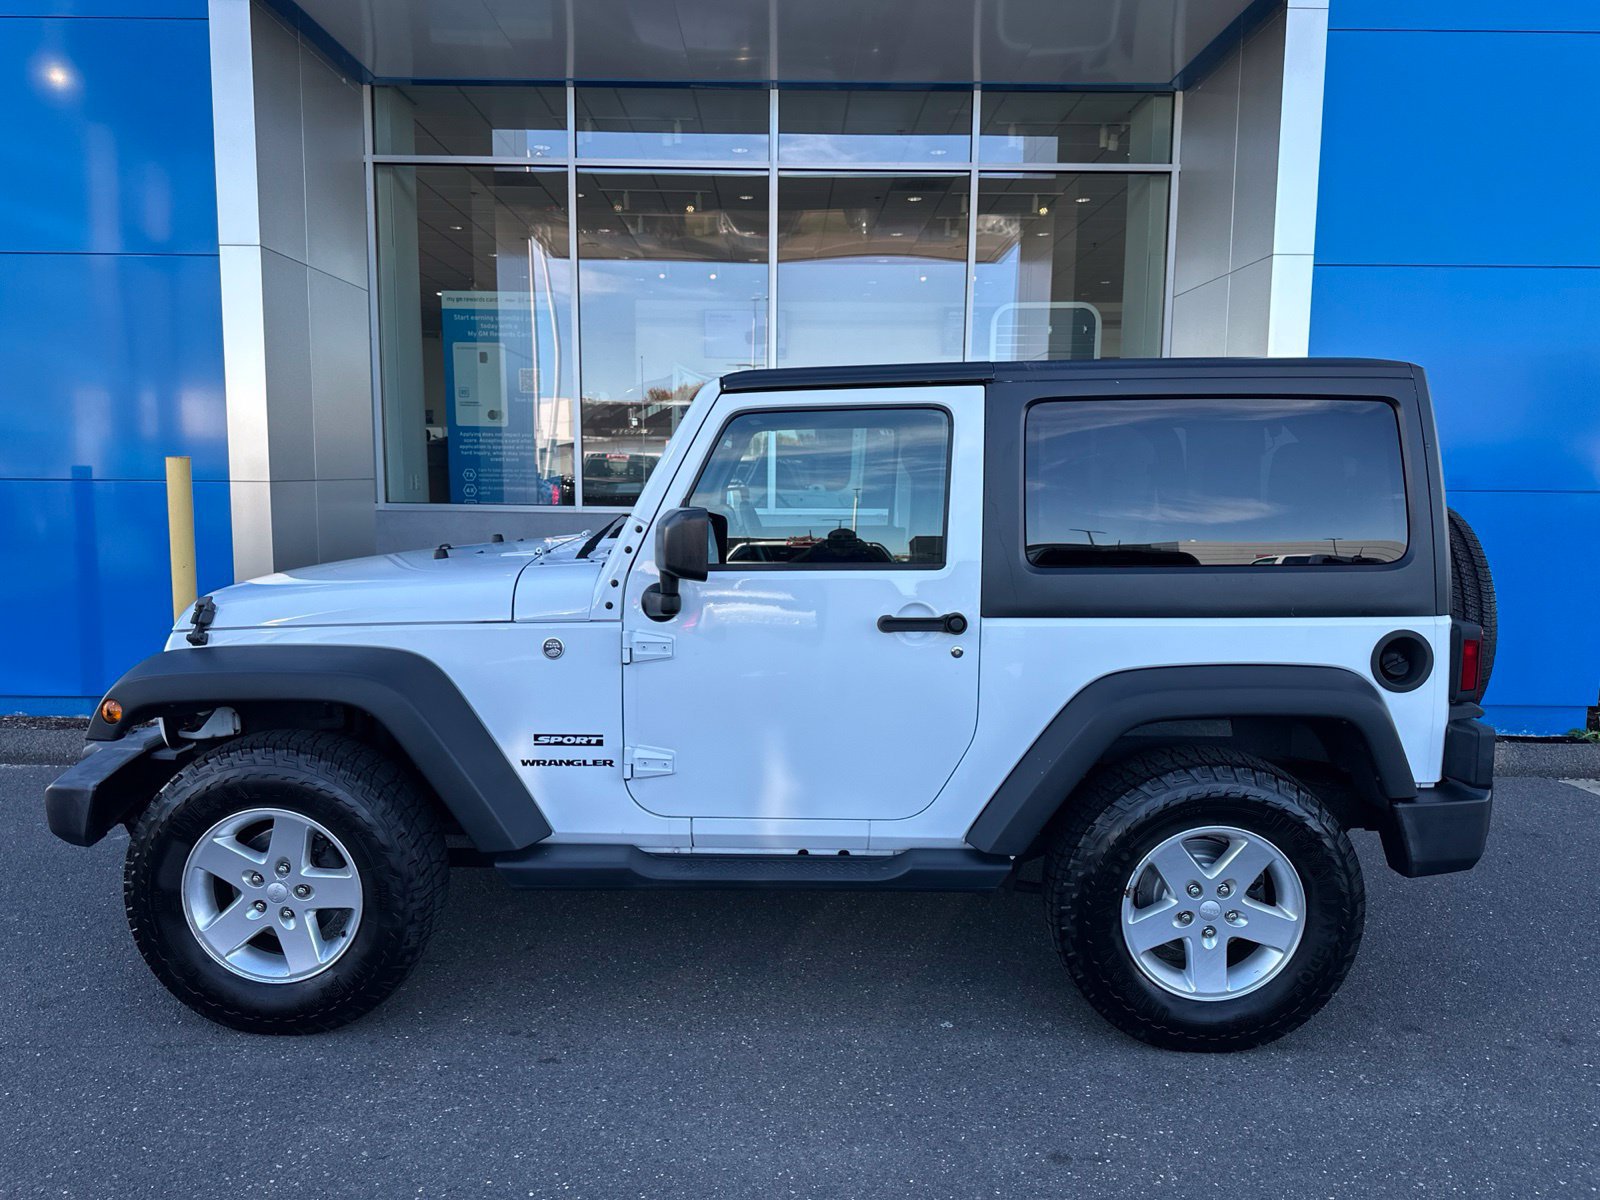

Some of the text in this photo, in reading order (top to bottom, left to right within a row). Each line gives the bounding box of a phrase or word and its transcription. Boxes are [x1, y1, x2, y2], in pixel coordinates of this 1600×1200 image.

[470, 314, 494, 322] earning
[467, 331, 477, 339] My
[534, 735, 603, 744] SPORT
[521, 759, 615, 767] WRANGLER
